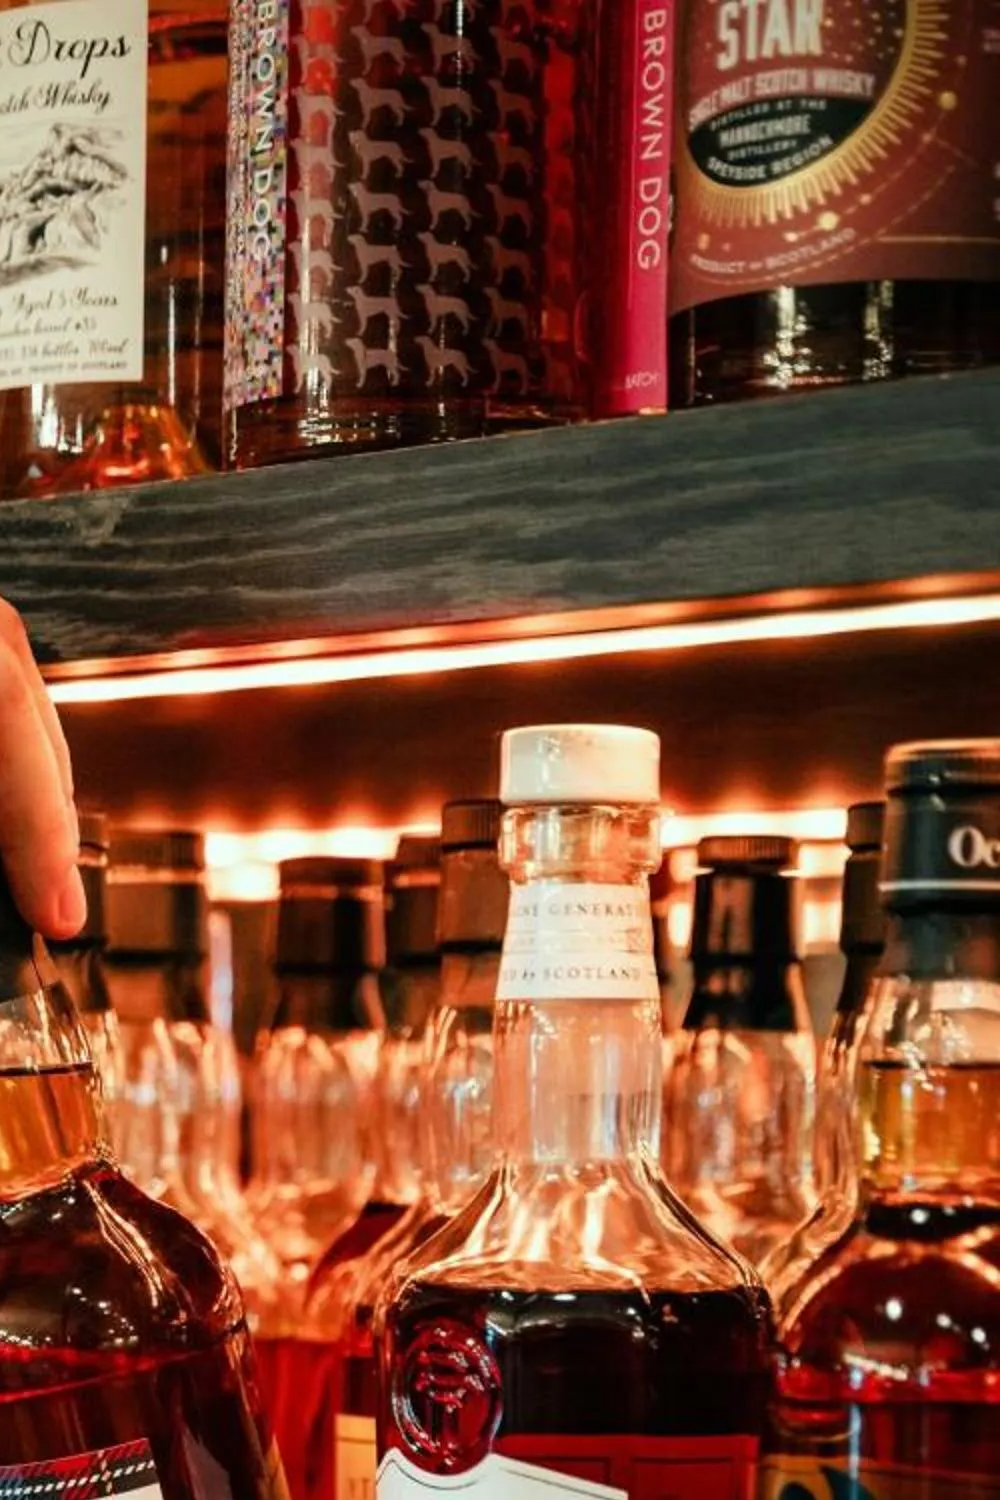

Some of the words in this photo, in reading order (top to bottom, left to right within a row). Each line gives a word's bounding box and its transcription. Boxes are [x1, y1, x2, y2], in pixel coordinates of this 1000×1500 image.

[8, 19, 133, 79] Drops
[255, 2, 275, 152] BROWN
[33, 77, 110, 115] Whisky
[640, 10, 668, 161] BROWN
[755, 68, 808, 96] SCOTCH
[813, 67, 876, 97] WHISKY
[706, 156, 766, 180] SPEYSIDE
[771, 135, 833, 175] REGION
[253, 168, 273, 262] DOG
[636, 176, 664, 270] DOG
[766, 227, 857, 270] SCOTLAND
